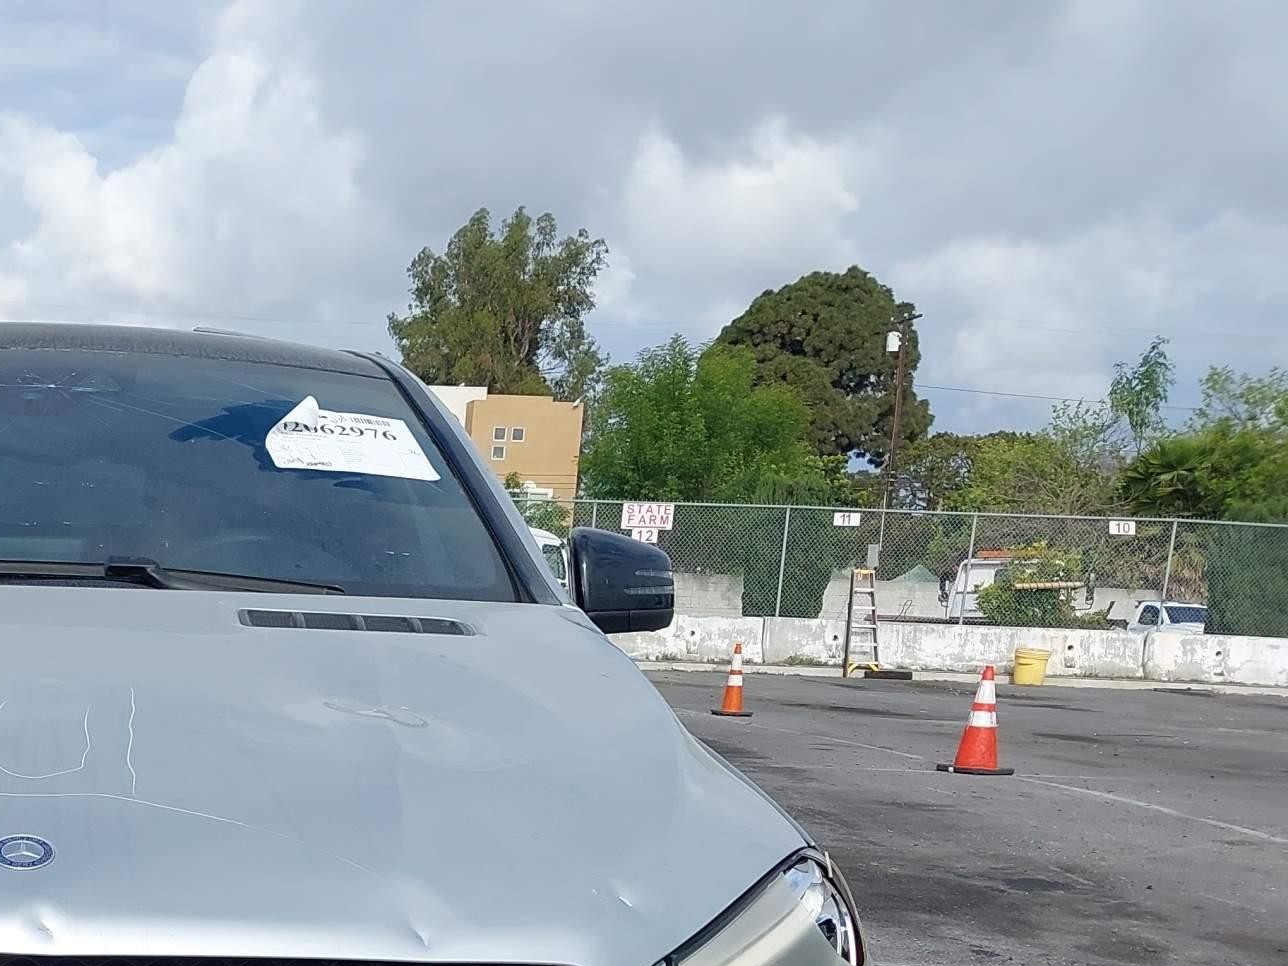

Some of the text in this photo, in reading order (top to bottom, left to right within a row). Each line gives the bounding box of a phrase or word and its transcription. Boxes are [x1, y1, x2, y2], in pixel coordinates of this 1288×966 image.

[626, 503, 672, 515] STATE
[627, 514, 670, 525] FARM
[840, 513, 851, 525] 11
[1114, 522, 1131, 534] 10
[637, 529, 654, 542] 12
